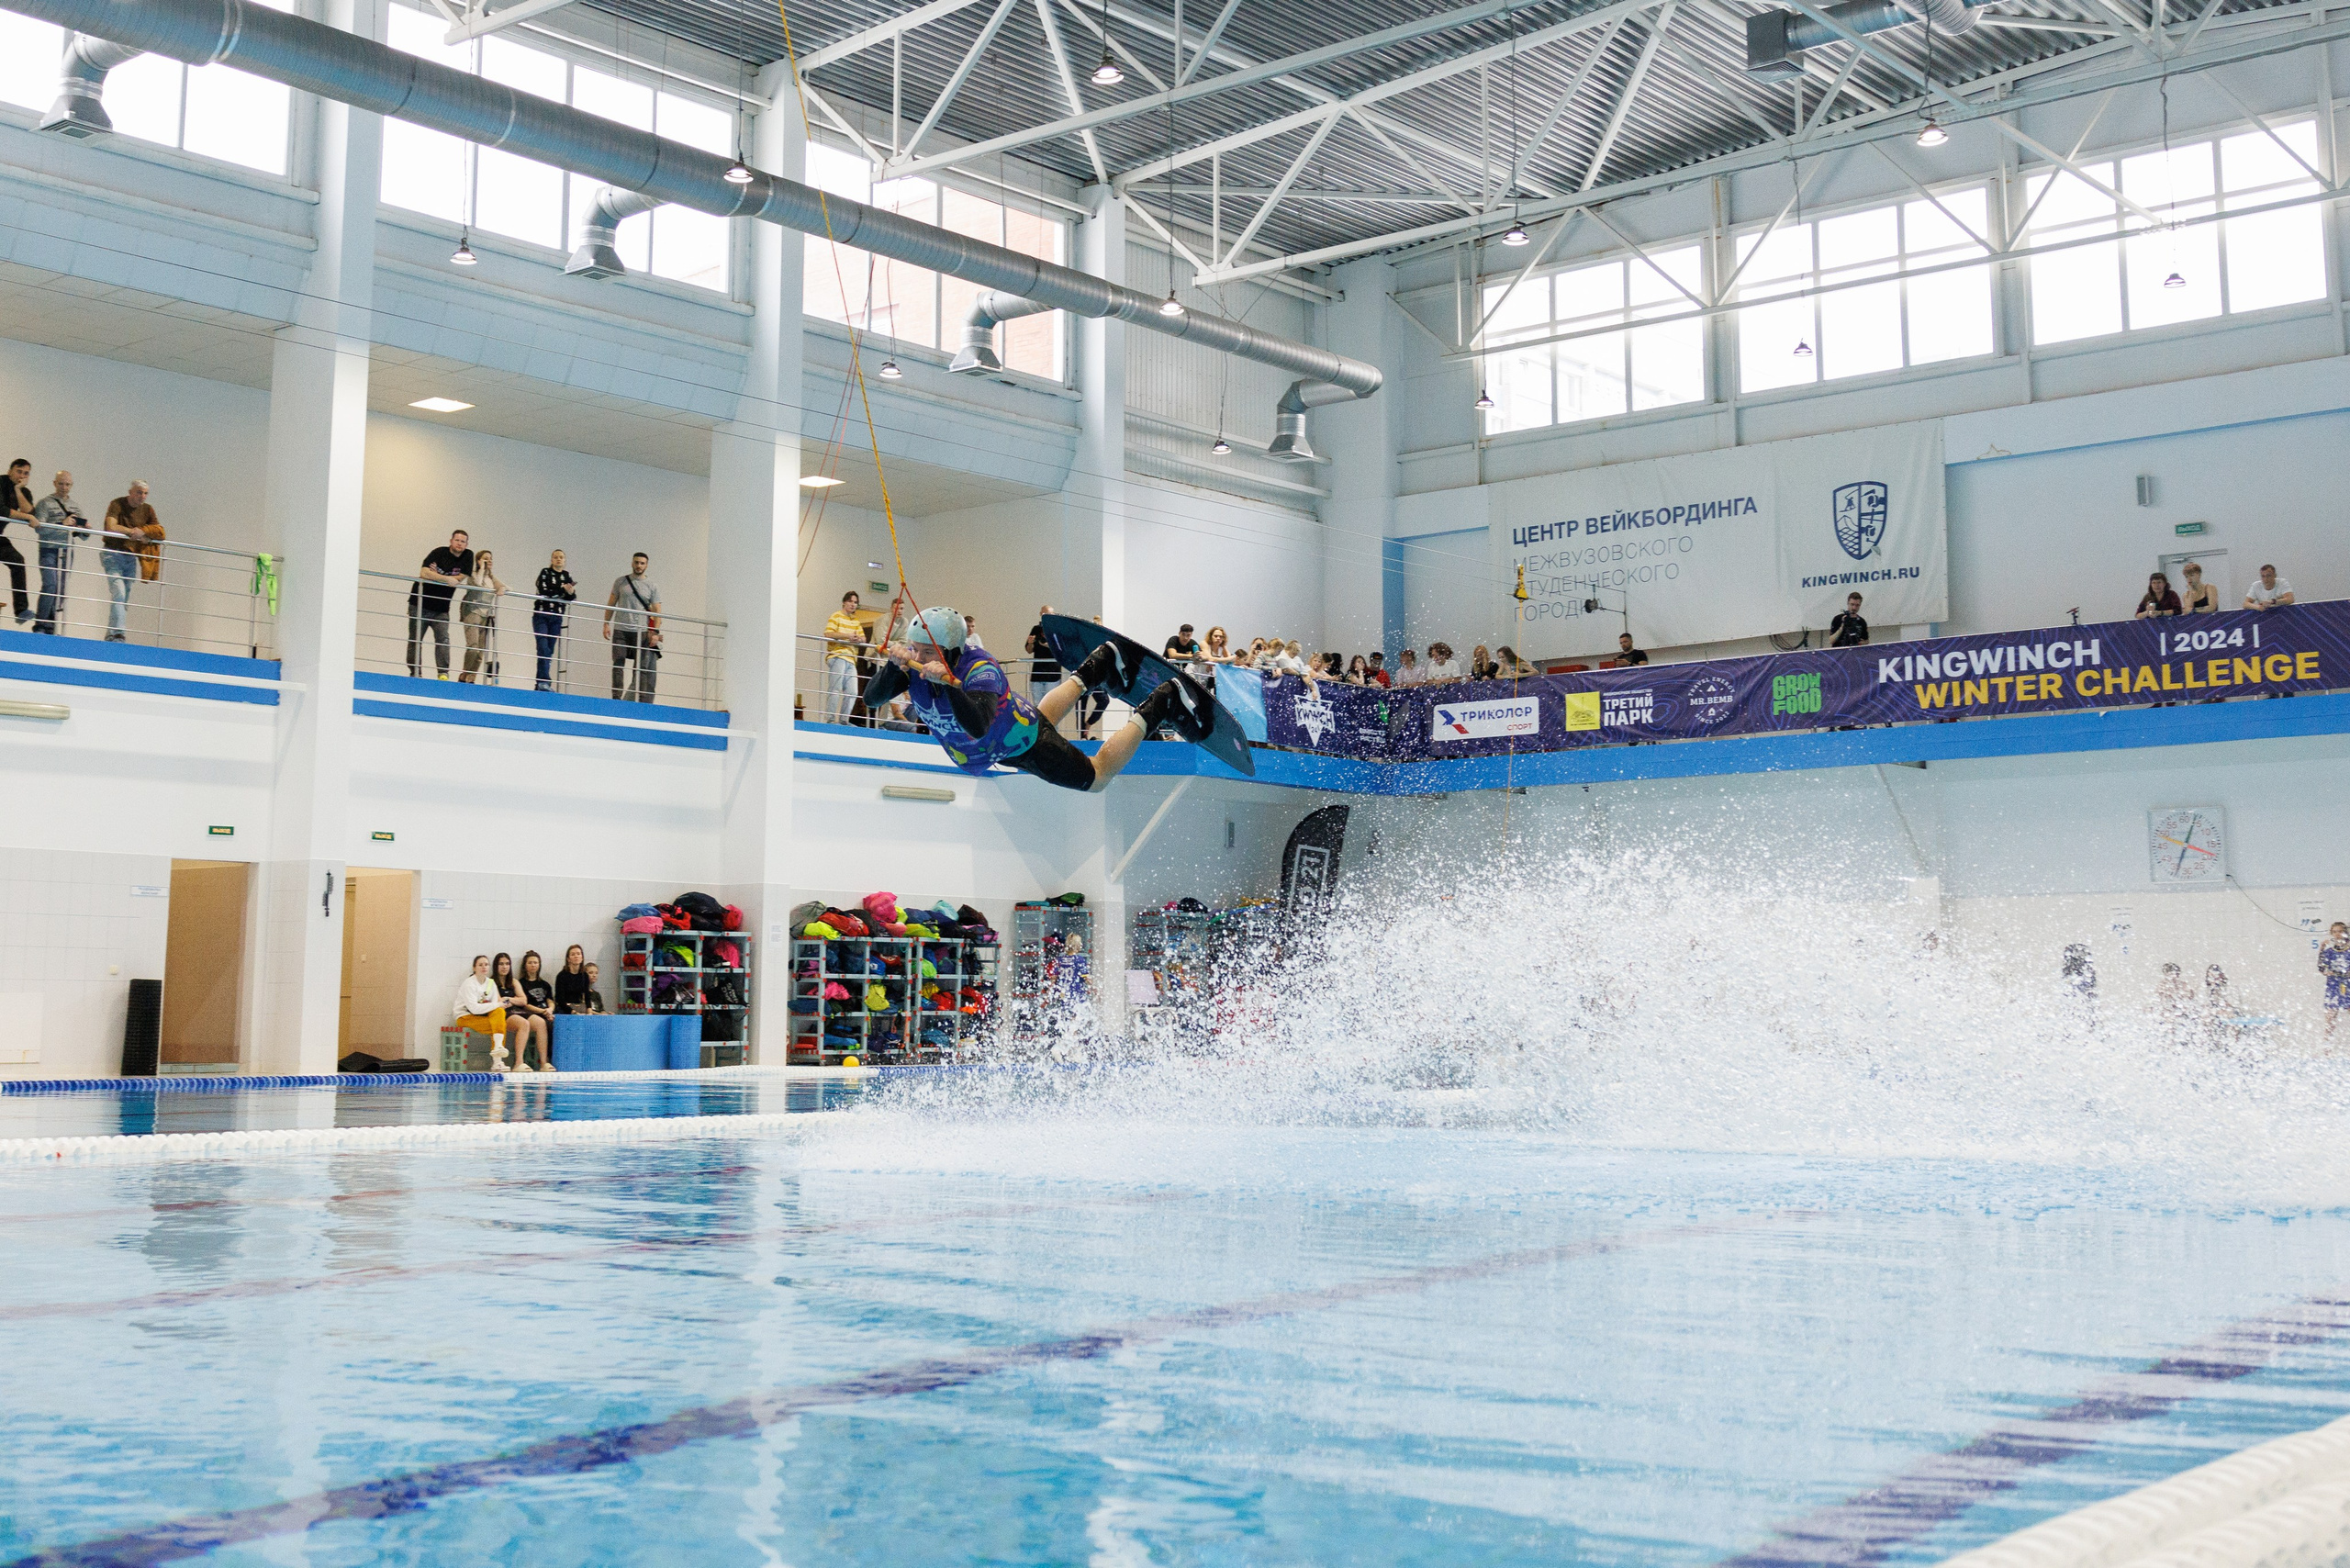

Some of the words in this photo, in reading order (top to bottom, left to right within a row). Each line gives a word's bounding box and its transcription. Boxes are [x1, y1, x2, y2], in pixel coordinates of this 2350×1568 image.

[1513, 520, 1579, 548] ЦЕНТР
[1585, 496, 1758, 535] ВЕЙКБОРДИНГА
[1513, 535, 1694, 574] МЕЖВУЗОВСКОГО
[1516, 562, 1680, 596] ТУДЕНЧЕСКОГО
[1802, 566, 1920, 588] KINGWINCH.RU
[1878, 639, 2101, 684] KINGWINCH
[1773, 672, 1821, 700] GROW
[1914, 673, 2064, 710] WINTER
[2076, 651, 2322, 697] CHALLENGE
[1603, 693, 1653, 711] ТРЕТИЙ
[1690, 696, 1733, 706] MR.BEMB
[1773, 688, 1822, 716] FOOD
[1460, 706, 1533, 722] ТРИКОЛОР
[1604, 708, 1654, 727] ПАРК
[1506, 722, 1533, 731] СПОРТ
[2179, 815, 2190, 823] 60
[1301, 855, 1320, 880] 21
[2311, 939, 2319, 949] 5
